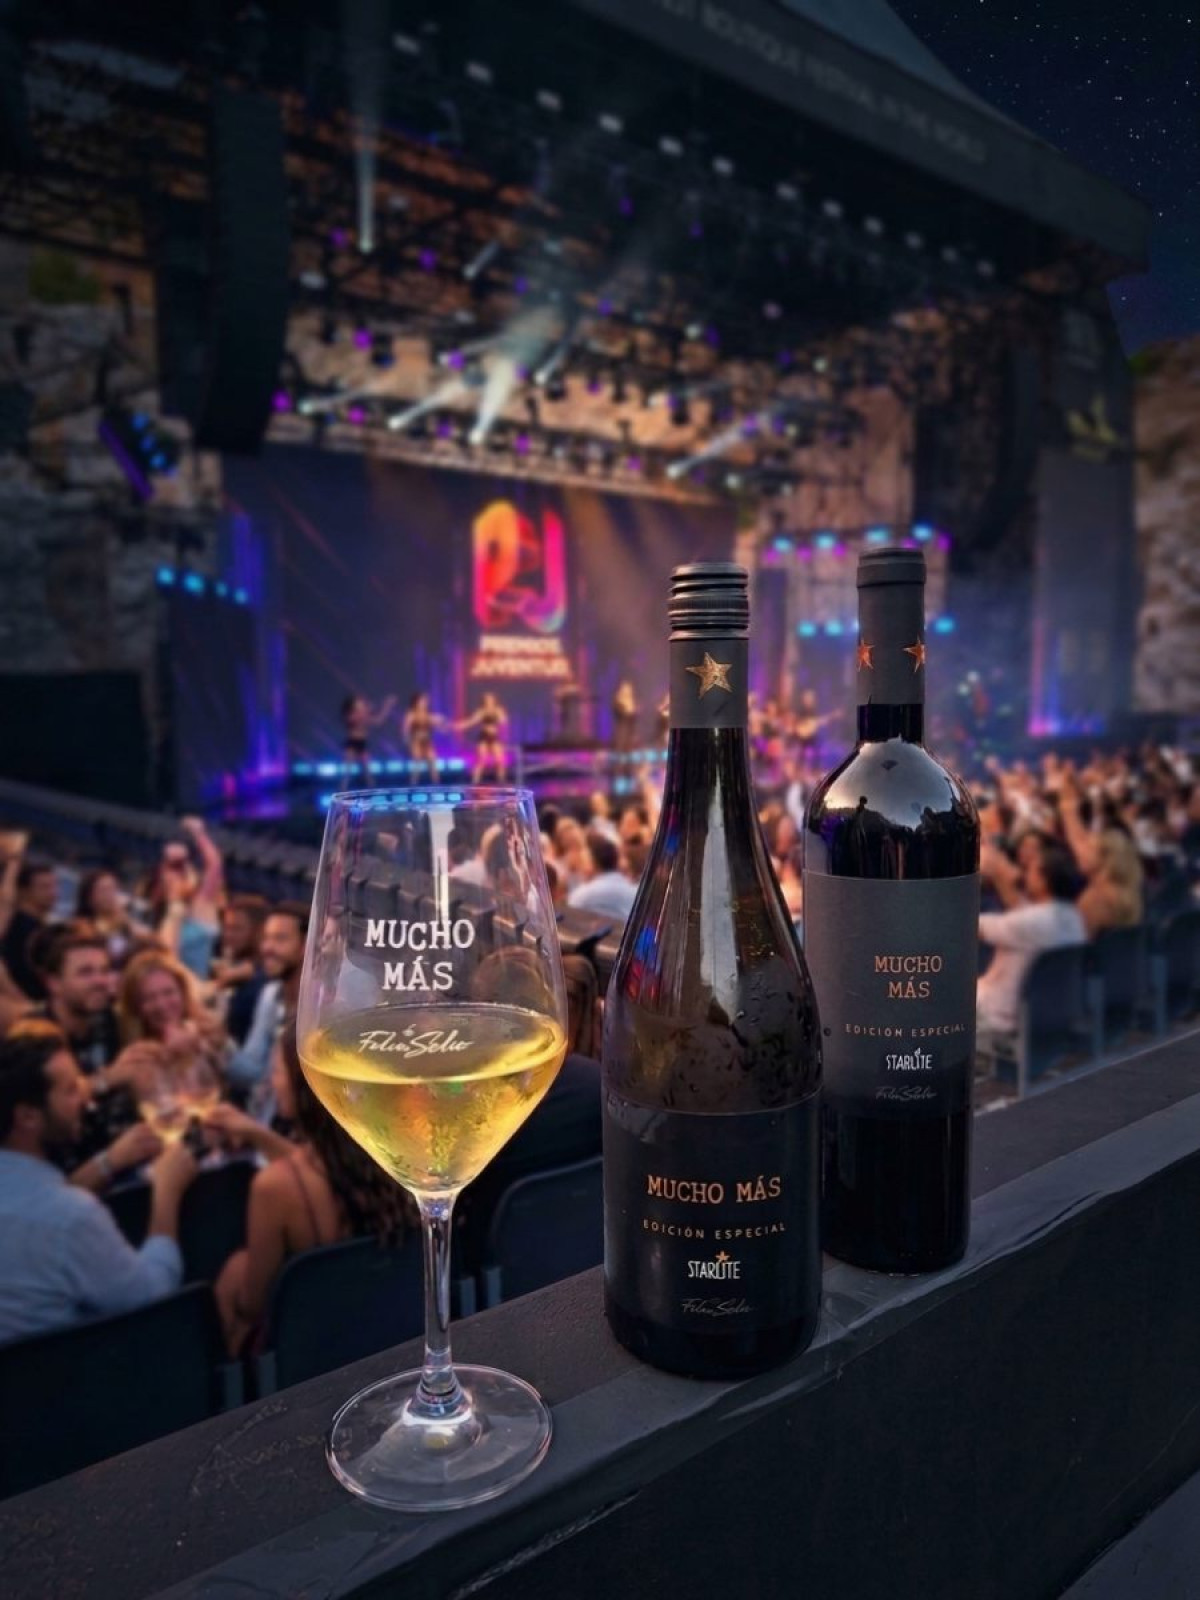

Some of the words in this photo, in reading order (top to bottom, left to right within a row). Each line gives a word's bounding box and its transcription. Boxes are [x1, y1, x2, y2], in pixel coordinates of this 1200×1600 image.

[364, 918, 475, 951] MUCHO
[382, 955, 453, 991] MÁS
[874, 955, 943, 973] MUCHO
[888, 975, 931, 998] MÁS
[911, 1023, 966, 1038] ESPECIAL
[647, 1174, 724, 1204] MUCHO
[735, 1175, 782, 1203] MÁS
[714, 1222, 786, 1240] ESPECIAL
